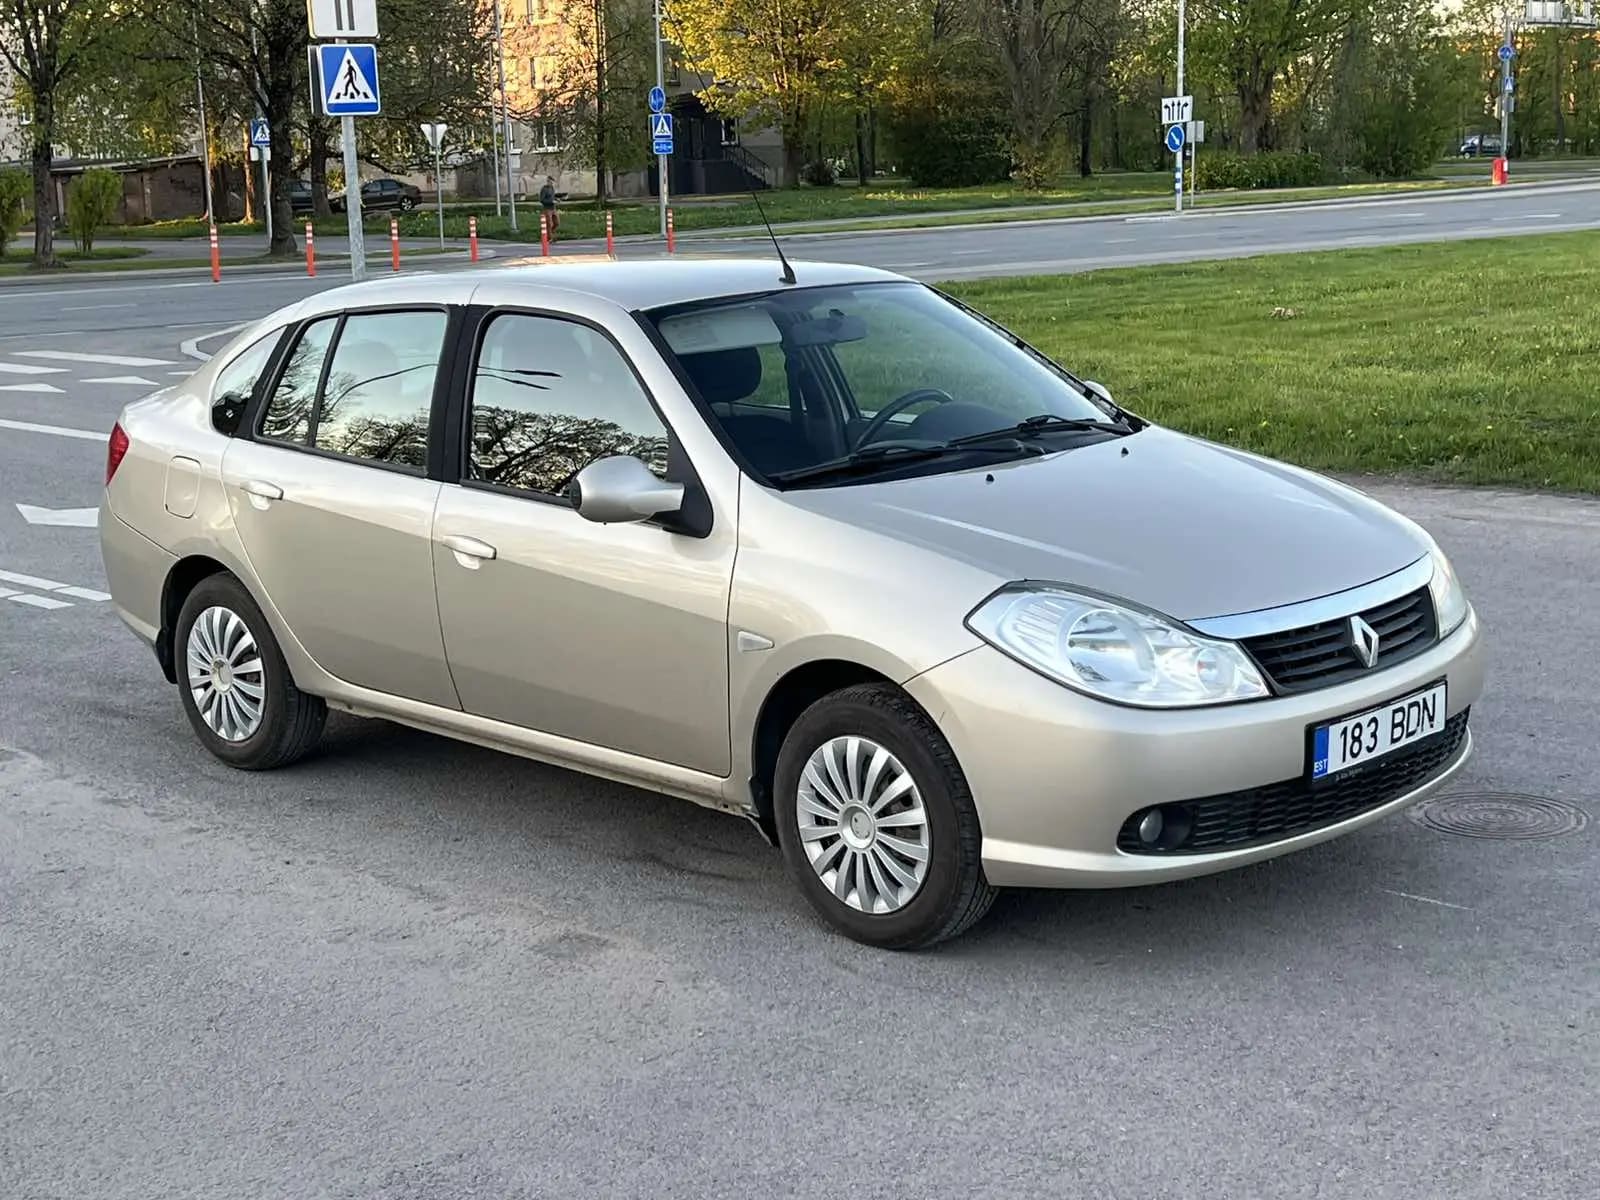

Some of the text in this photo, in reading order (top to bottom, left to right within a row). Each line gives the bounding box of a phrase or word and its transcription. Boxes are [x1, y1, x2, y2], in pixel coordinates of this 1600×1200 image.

[1340, 693, 1436, 763] 183 BDN
[1314, 759, 1328, 773] EST
